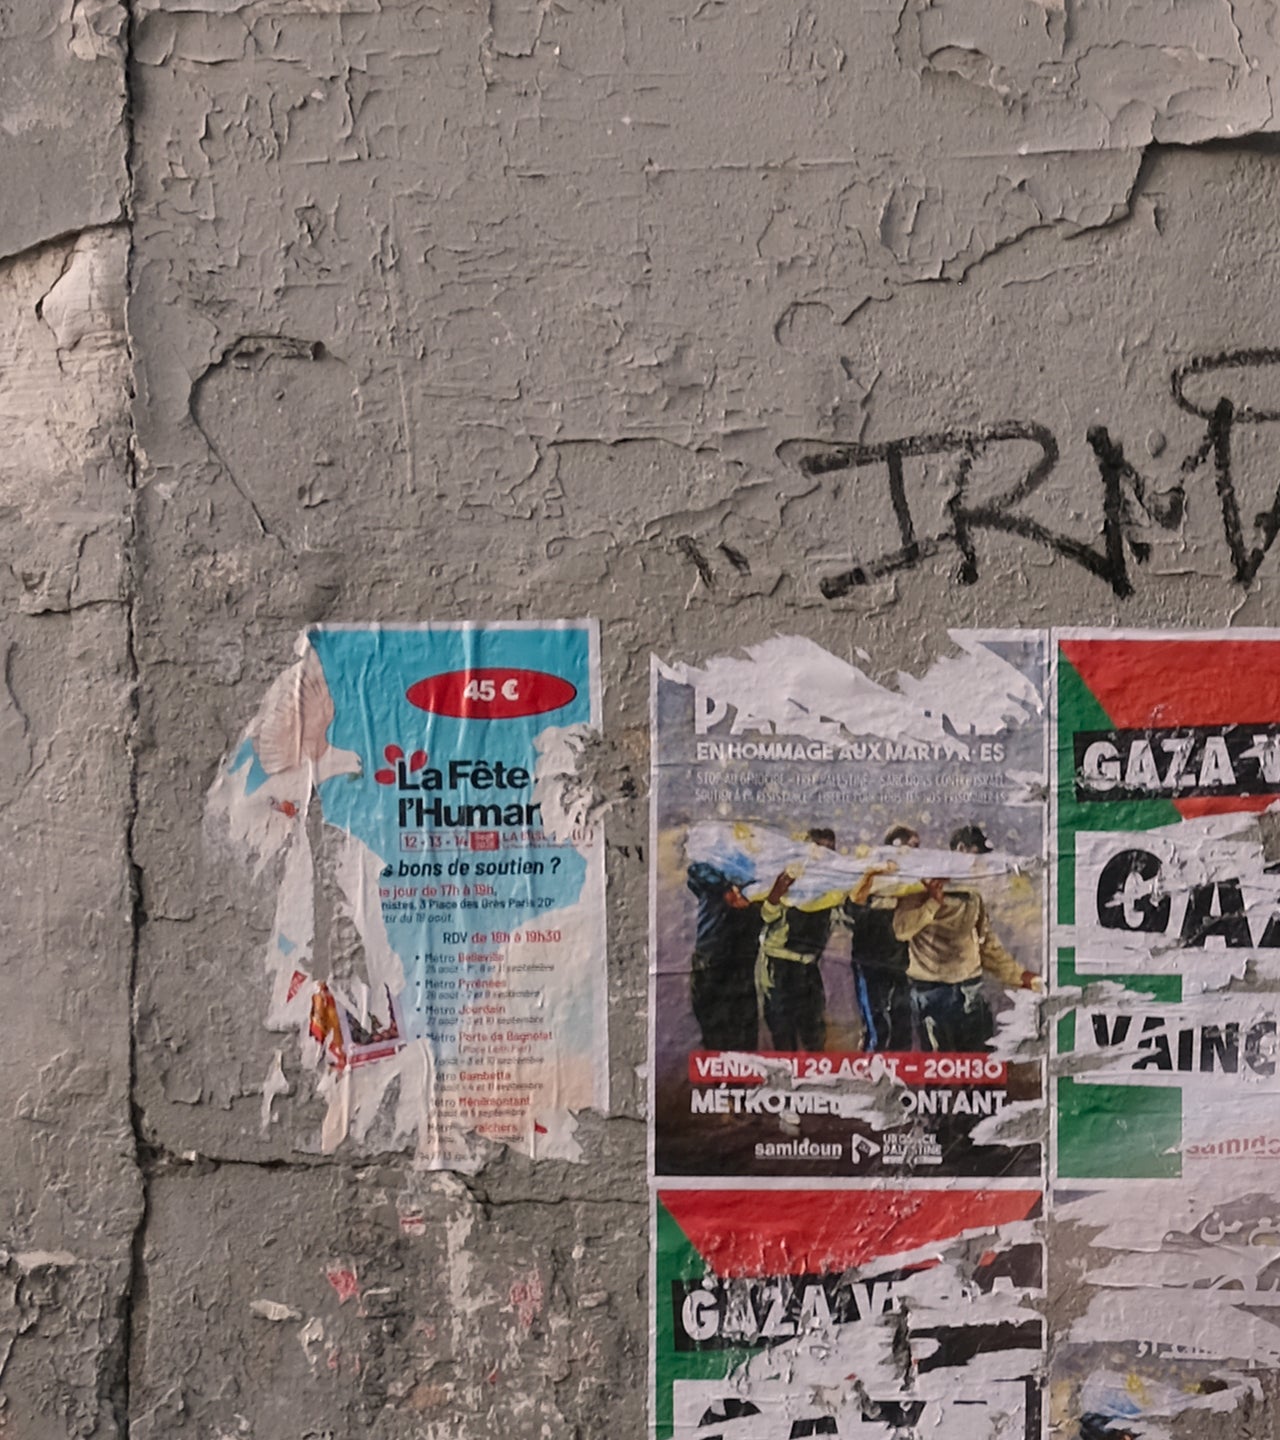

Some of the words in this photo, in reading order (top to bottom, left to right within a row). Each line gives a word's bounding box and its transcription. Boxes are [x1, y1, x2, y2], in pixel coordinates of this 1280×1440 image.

[464, 679, 495, 701] 45
[501, 678, 519, 701] €
[697, 742, 724, 760] EN
[728, 742, 833, 761] HOMMAGE
[839, 742, 881, 761] AUX
[1083, 733, 1237, 791] GAZA
[398, 761, 443, 791] La
[450, 760, 530, 790] Fête
[398, 859, 443, 877] bons
[448, 858, 470, 876] de
[475, 858, 545, 876] soutien
[393, 885, 418, 900] jour
[443, 931, 468, 944] RDV
[807, 1057, 833, 1077] 29
